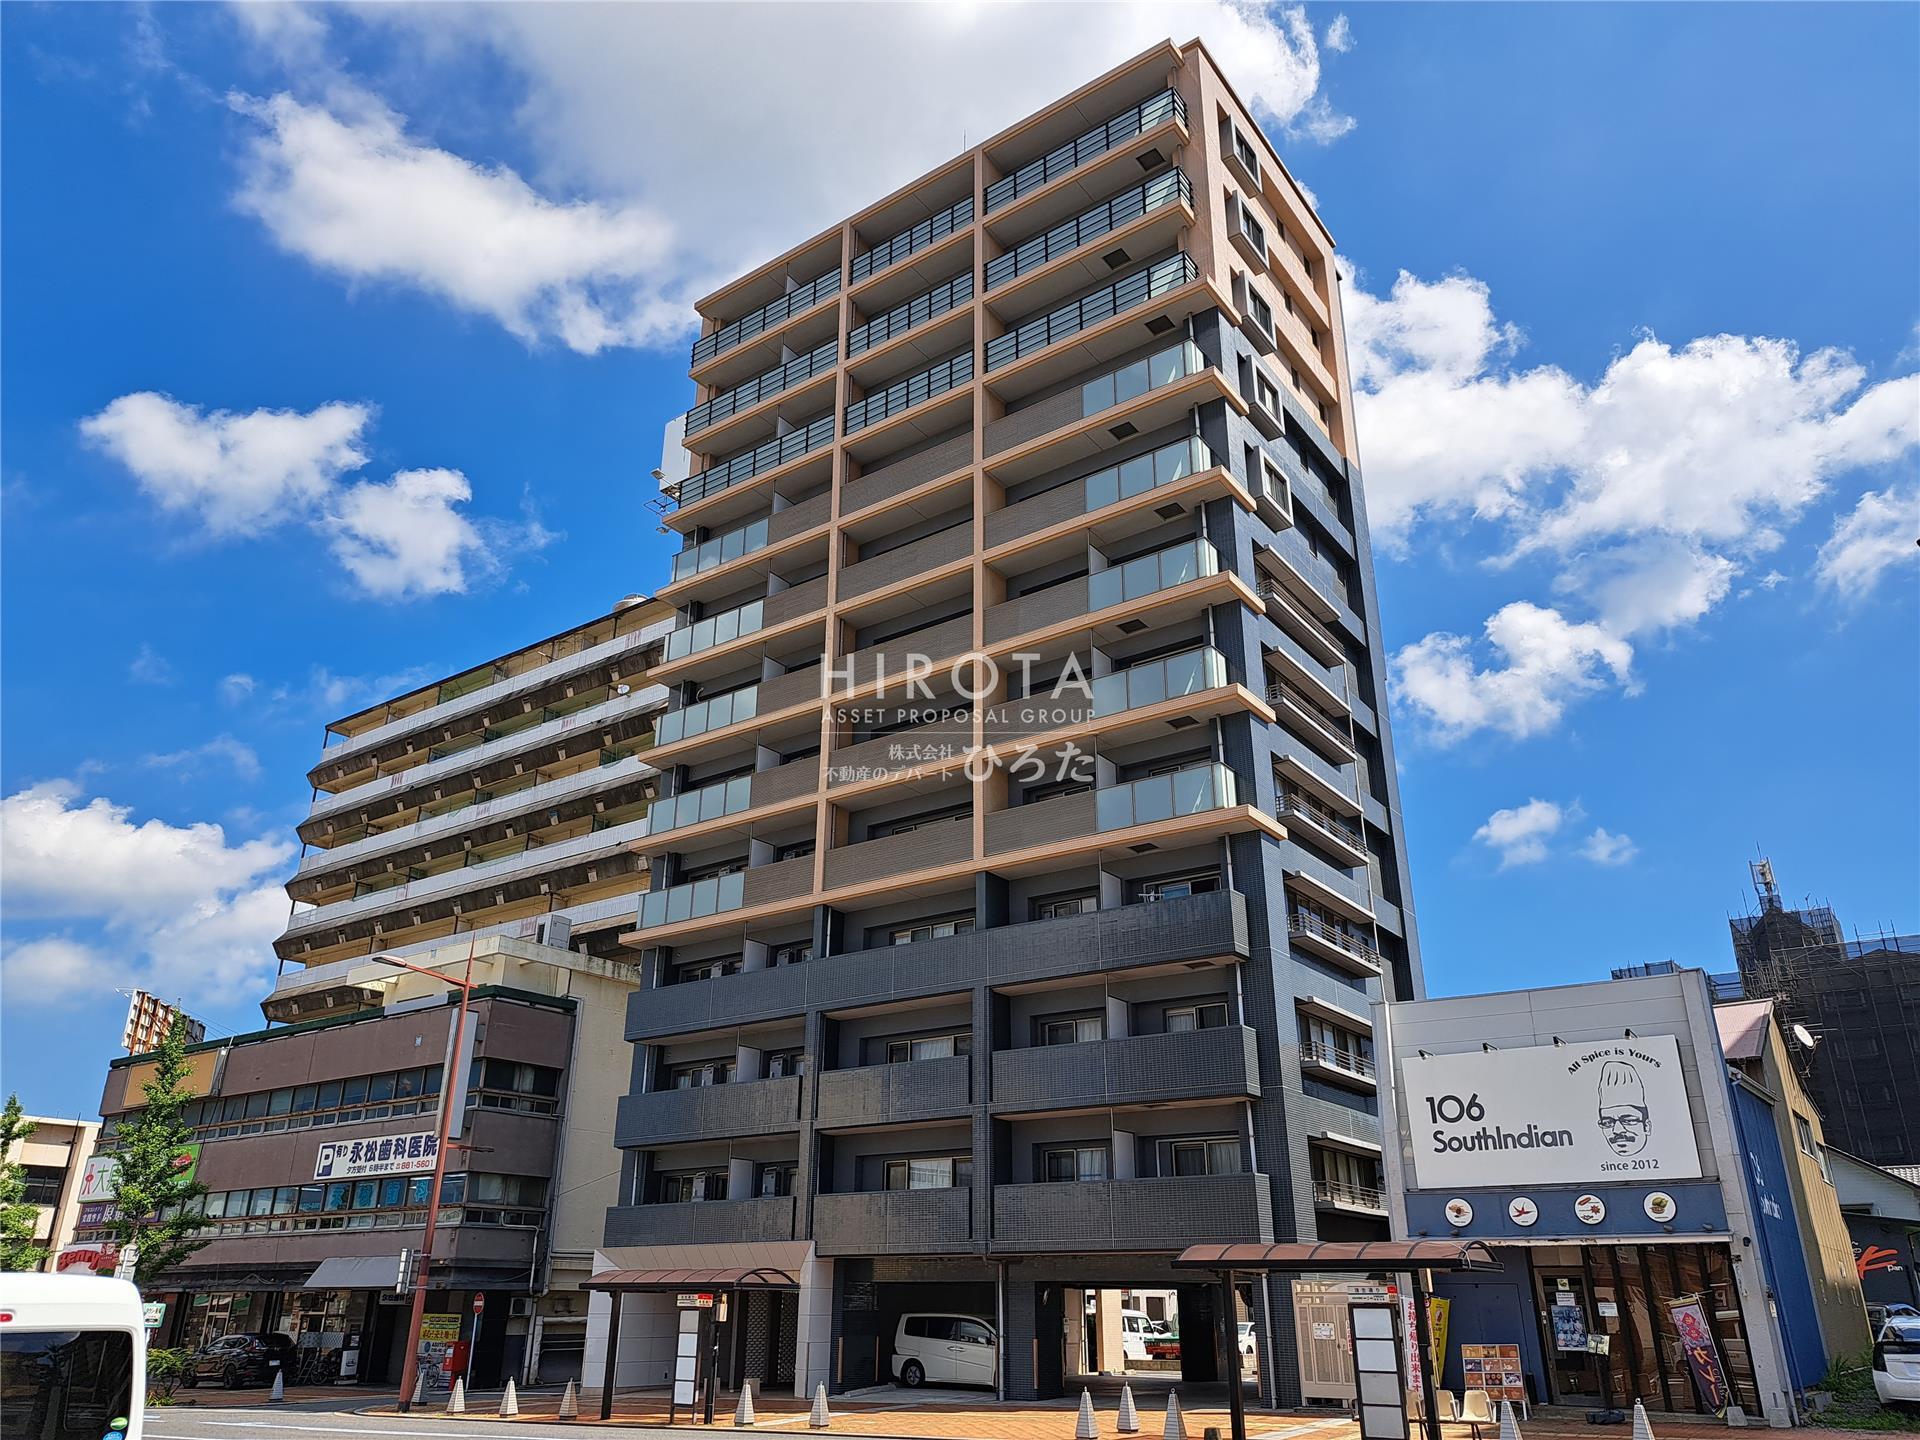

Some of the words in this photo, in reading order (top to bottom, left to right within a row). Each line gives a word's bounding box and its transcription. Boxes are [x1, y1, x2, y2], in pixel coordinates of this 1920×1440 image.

[1567, 1060, 1581, 1075] All
[1581, 1047, 1611, 1064] Spice
[1614, 1047, 1625, 1056] is
[1628, 1048, 1662, 1068] Yours
[1425, 1093, 1485, 1124] 106
[349, 1134, 439, 1164] 永松歯科医院
[1432, 1123, 1574, 1153] SouthIndian
[1600, 1160, 1629, 1172] since
[1631, 1159, 1660, 1171] 2012
